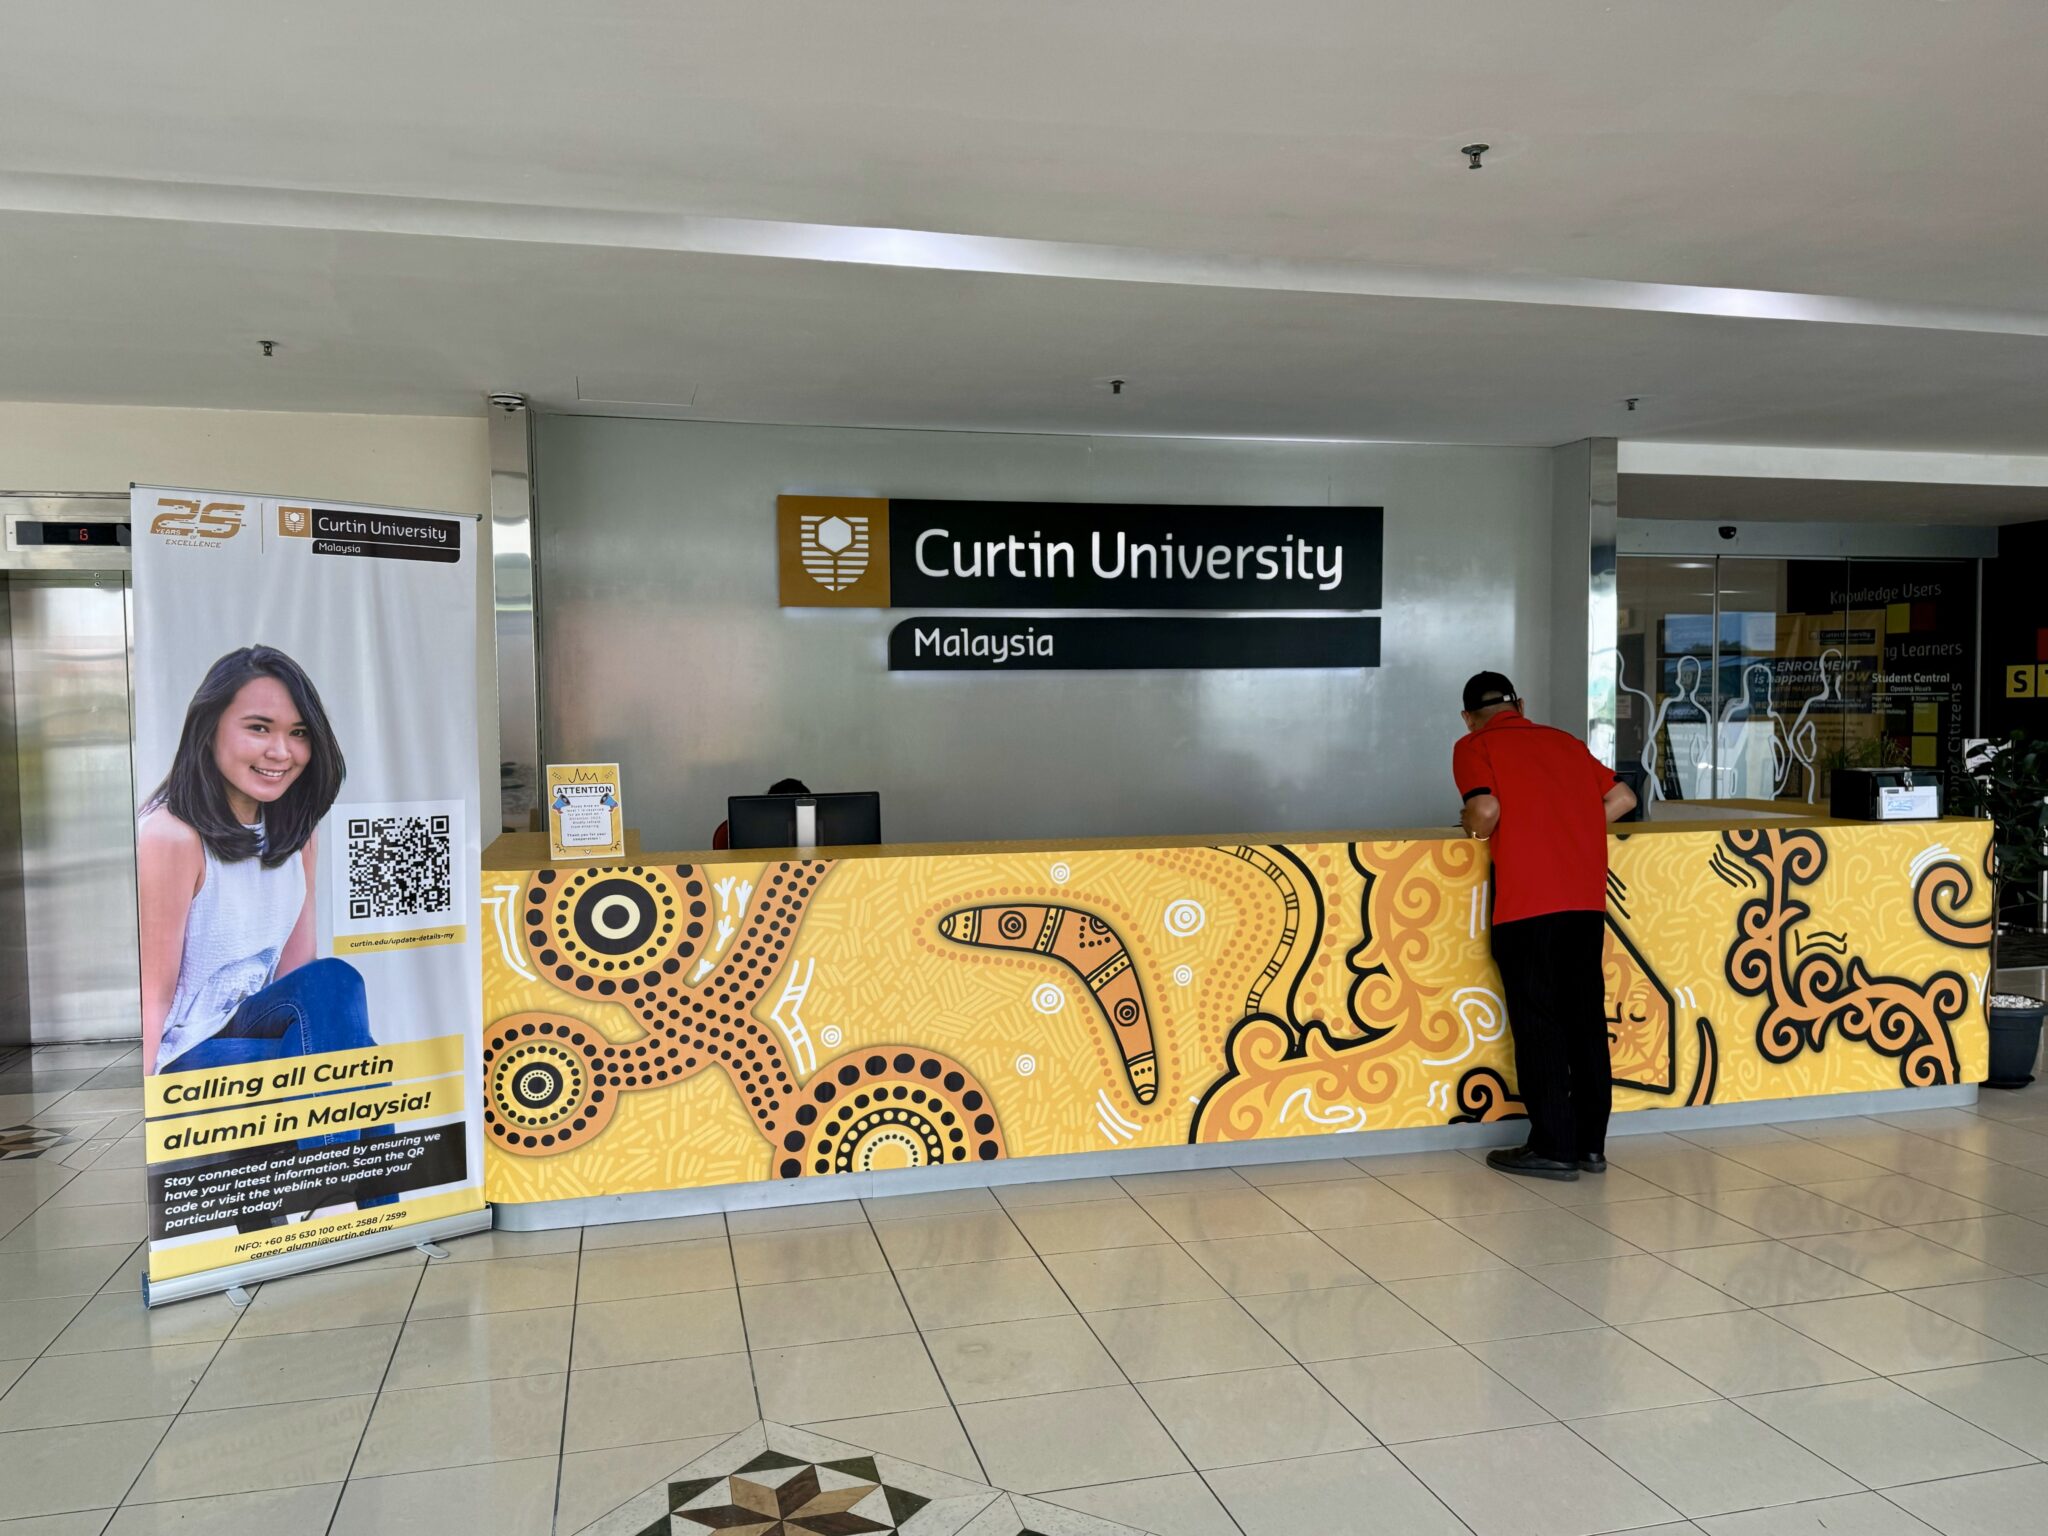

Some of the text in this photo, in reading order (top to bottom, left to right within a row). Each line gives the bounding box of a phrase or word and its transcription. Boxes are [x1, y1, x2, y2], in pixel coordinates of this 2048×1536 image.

[150, 498, 245, 538] 25
[318, 517, 447, 542] Curtin University
[165, 539, 221, 548] EXCELLENCE
[318, 542, 361, 554] Malaysia
[915, 528, 1343, 591] Curtin University
[1830, 582, 1942, 605] Knowledge Users
[914, 627, 1054, 663] Malaysia
[1901, 643, 1963, 658] Learners
[1754, 673, 1766, 685] is
[1872, 672, 1950, 683] Student Central
[1948, 682, 1963, 752] Citizens
[557, 786, 612, 794] ATTENTION
[350, 932, 454, 948] curtin.edu/update-details-my
[162, 1055, 394, 1105] Calling all Curtin
[163, 1091, 432, 1151] alumni in Malaysia!
[164, 1133, 440, 1188] Stay connected and updated by ensuring we
[165, 1147, 424, 1201] have your latest information. Scan the QR
[165, 1162, 412, 1215] code or visit the weblink to update your
[165, 1199, 283, 1231] particulars today!
[234, 1242, 262, 1253] INFO:
[265, 1237, 282, 1246] +60
[285, 1234, 296, 1242] 85
[299, 1230, 316, 1239] 630
[319, 1226, 335, 1235] 100
[337, 1223, 353, 1231] ext.
[356, 1217, 378, 1228] 2588
[386, 1211, 407, 1221] 2599
